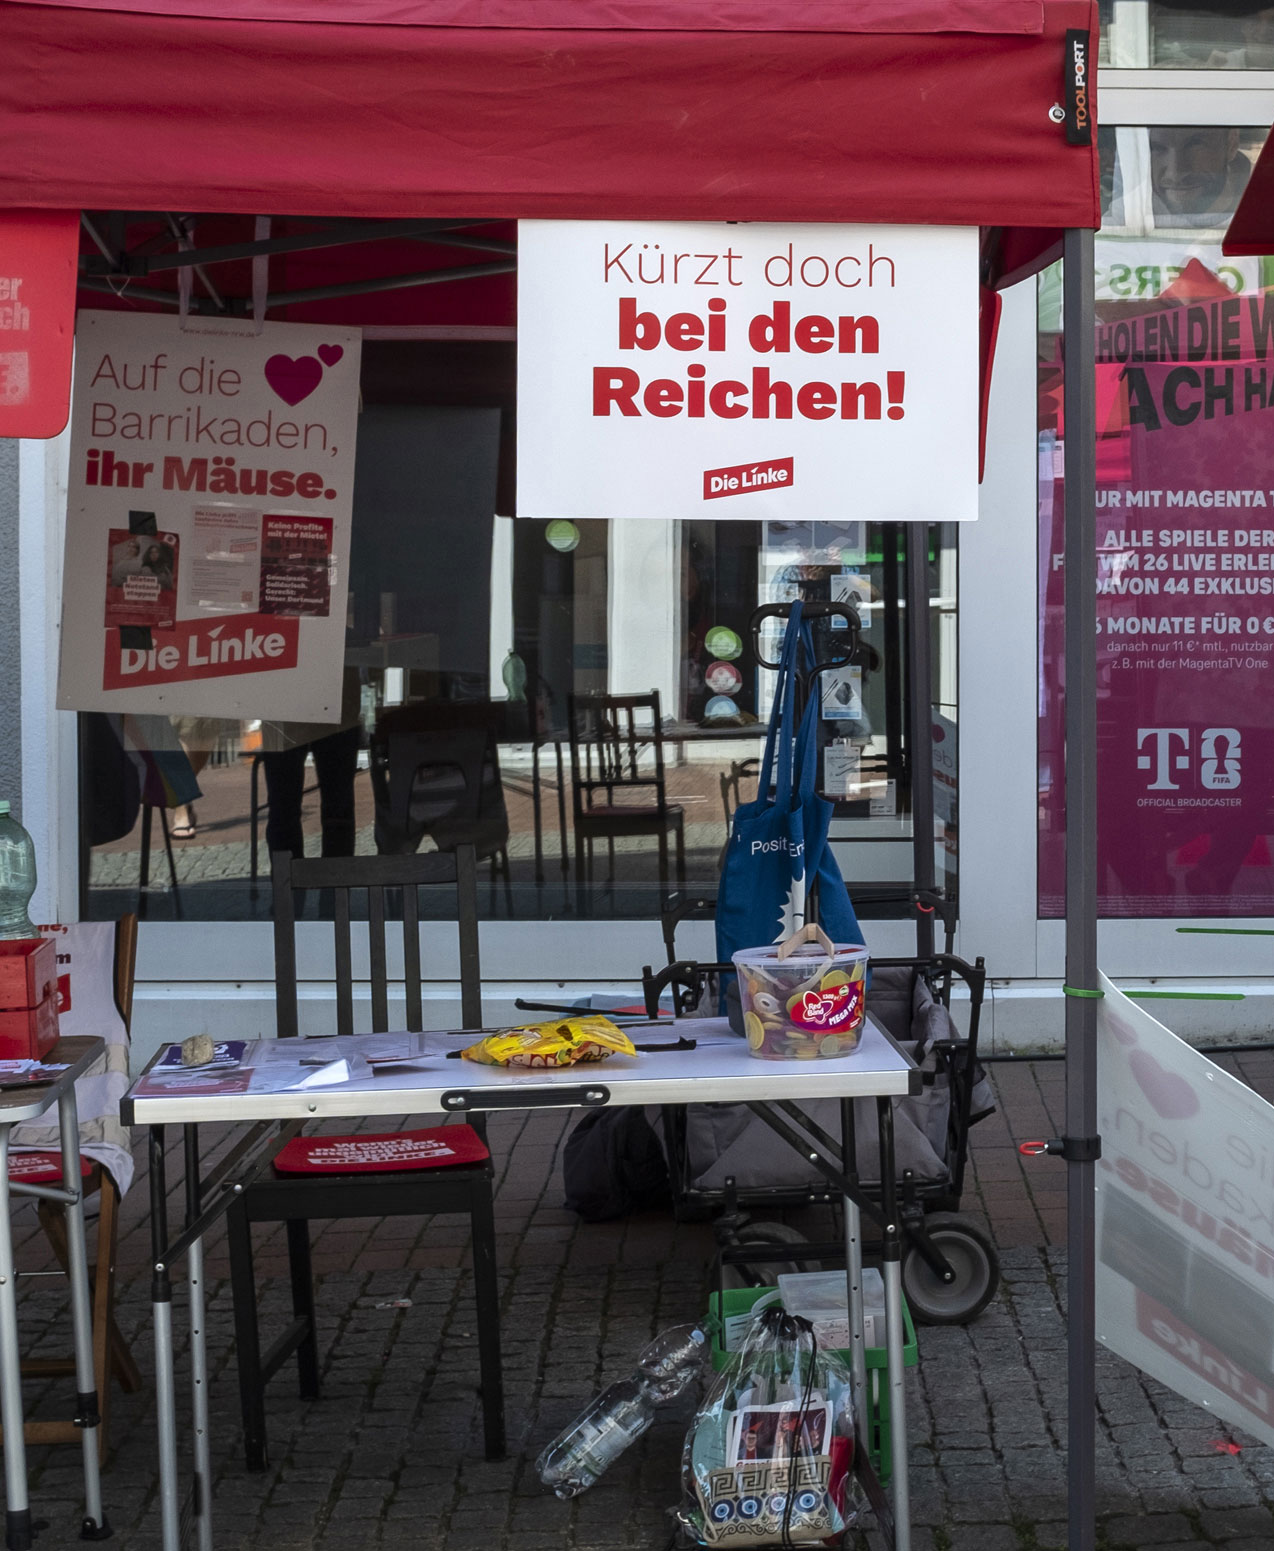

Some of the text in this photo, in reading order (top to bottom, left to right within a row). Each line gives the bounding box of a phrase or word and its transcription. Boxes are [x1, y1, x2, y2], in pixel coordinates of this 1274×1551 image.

[1074, 41, 1086, 130] TOOLPORT
[603, 242, 895, 287] Kürzt doch
[618, 298, 879, 354] bei den
[1099, 310, 1179, 363] HOLEN
[1188, 299, 1240, 363] DIE
[90, 353, 242, 397] Auf die
[592, 364, 906, 421] Reichen!
[91, 403, 339, 457] Barrikaden,
[86, 448, 337, 500] ihr Mäuse.
[710, 465, 788, 493] Die Linke
[1126, 490, 1164, 507] MIT
[1166, 490, 1266, 507] MAGENTA
[1104, 530, 1153, 547] ALLE
[1159, 530, 1228, 547] SPIELE
[1143, 554, 1168, 570] 26
[1173, 554, 1217, 570] LIVE
[1163, 578, 1190, 595] 44
[1107, 617, 1195, 634] MONATE
[1201, 613, 1242, 634] FÜR
[120, 624, 285, 675] Die Linke
[1107, 641, 1149, 651] danach
[1151, 643, 1170, 651] nur
[1230, 641, 1274, 651] nutzbar
[1136, 658, 1155, 669] mit
[1157, 658, 1176, 669] der
[1179, 658, 1244, 671] MagentaTV
[1245, 658, 1269, 669] One
[1212, 776, 1231, 784] FIFA
[1137, 798, 1242, 807] OFFICIAL BROADCASTER
[807, 1007, 824, 1017] Band
[808, 1003, 822, 1011] Red
[828, 1009, 849, 1026] MEGA
[847, 995, 858, 1012] MIX
